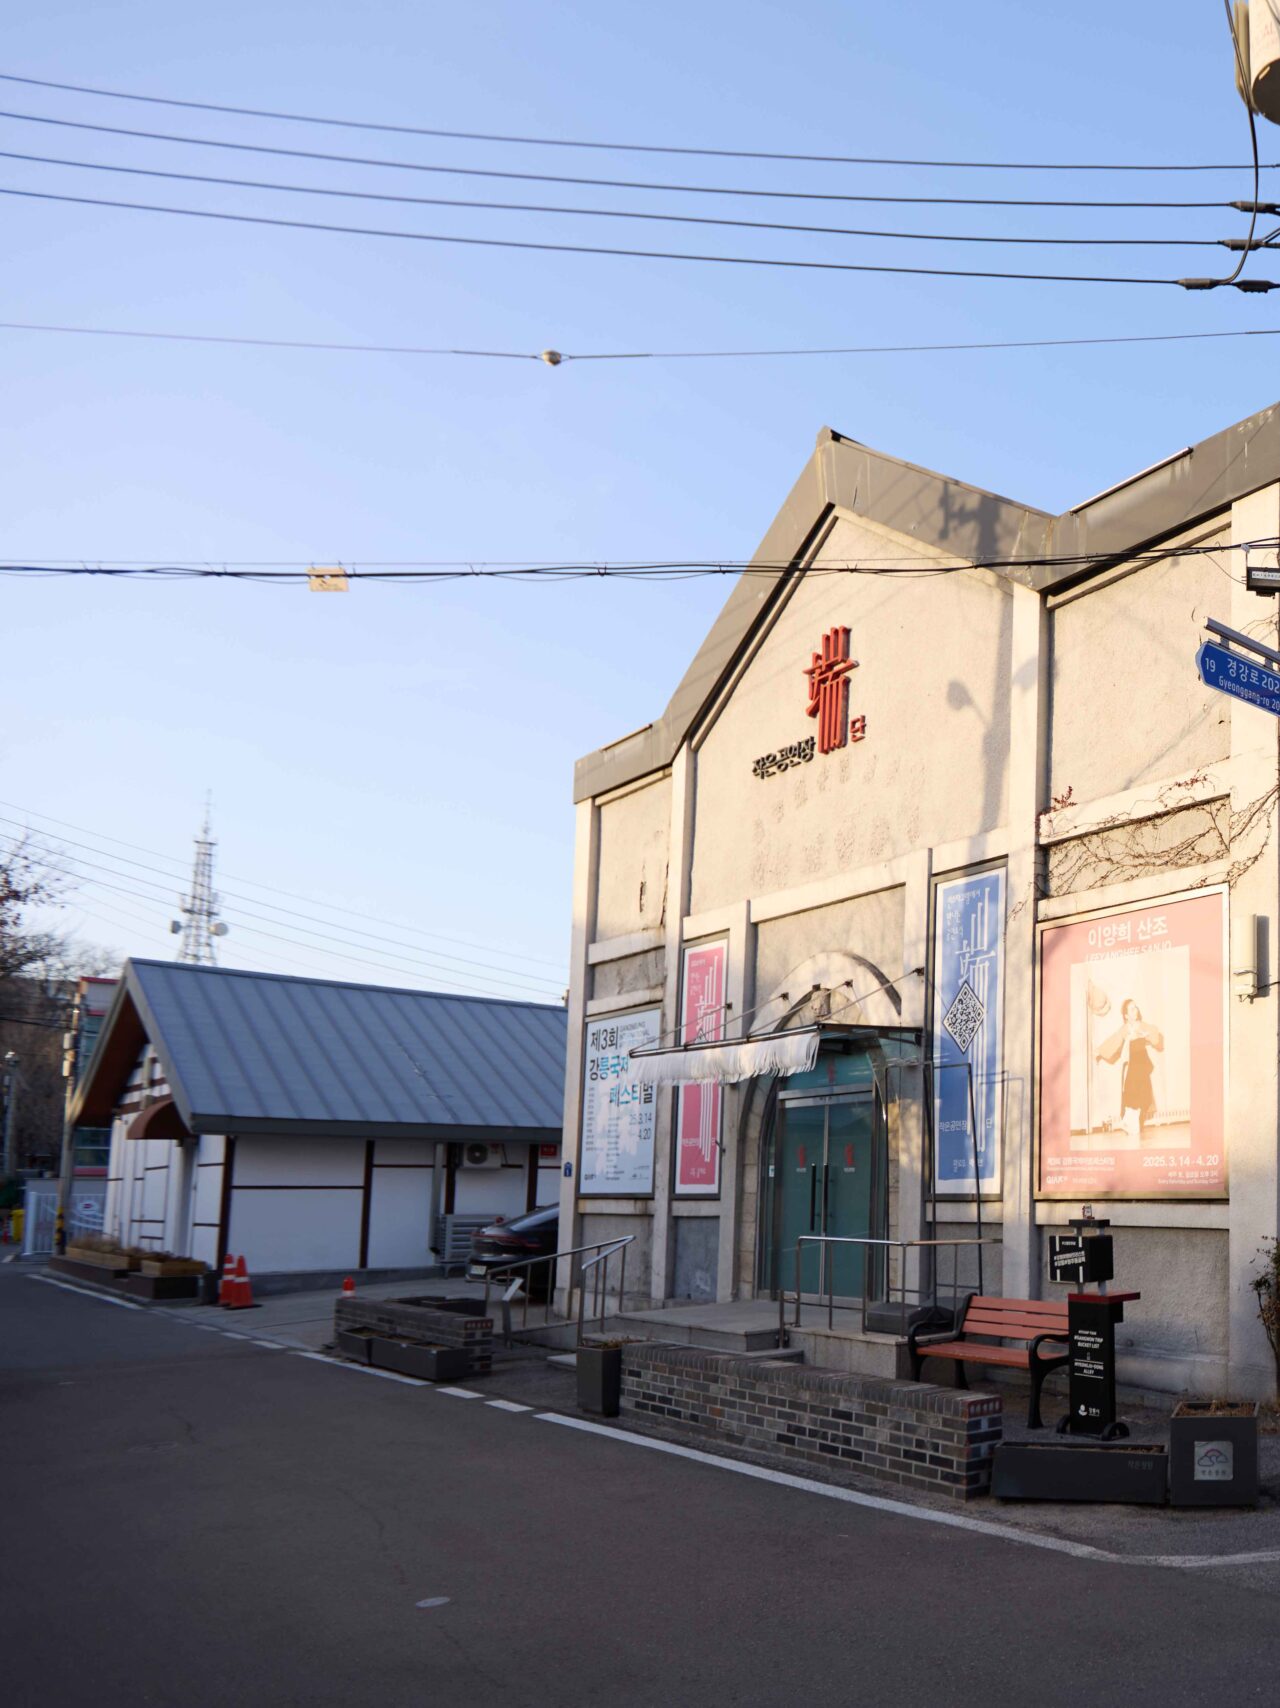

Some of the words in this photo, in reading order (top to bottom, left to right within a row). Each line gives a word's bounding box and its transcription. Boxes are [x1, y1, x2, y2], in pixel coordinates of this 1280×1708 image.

[1205, 657, 1216, 673] 19
[1218, 675, 1270, 706] Gyeonggang-ro
[850, 715, 866, 743] 단
[1088, 920, 1132, 949] 이양희
[1136, 915, 1169, 941] 산조
[590, 1025, 619, 1052] 제3회
